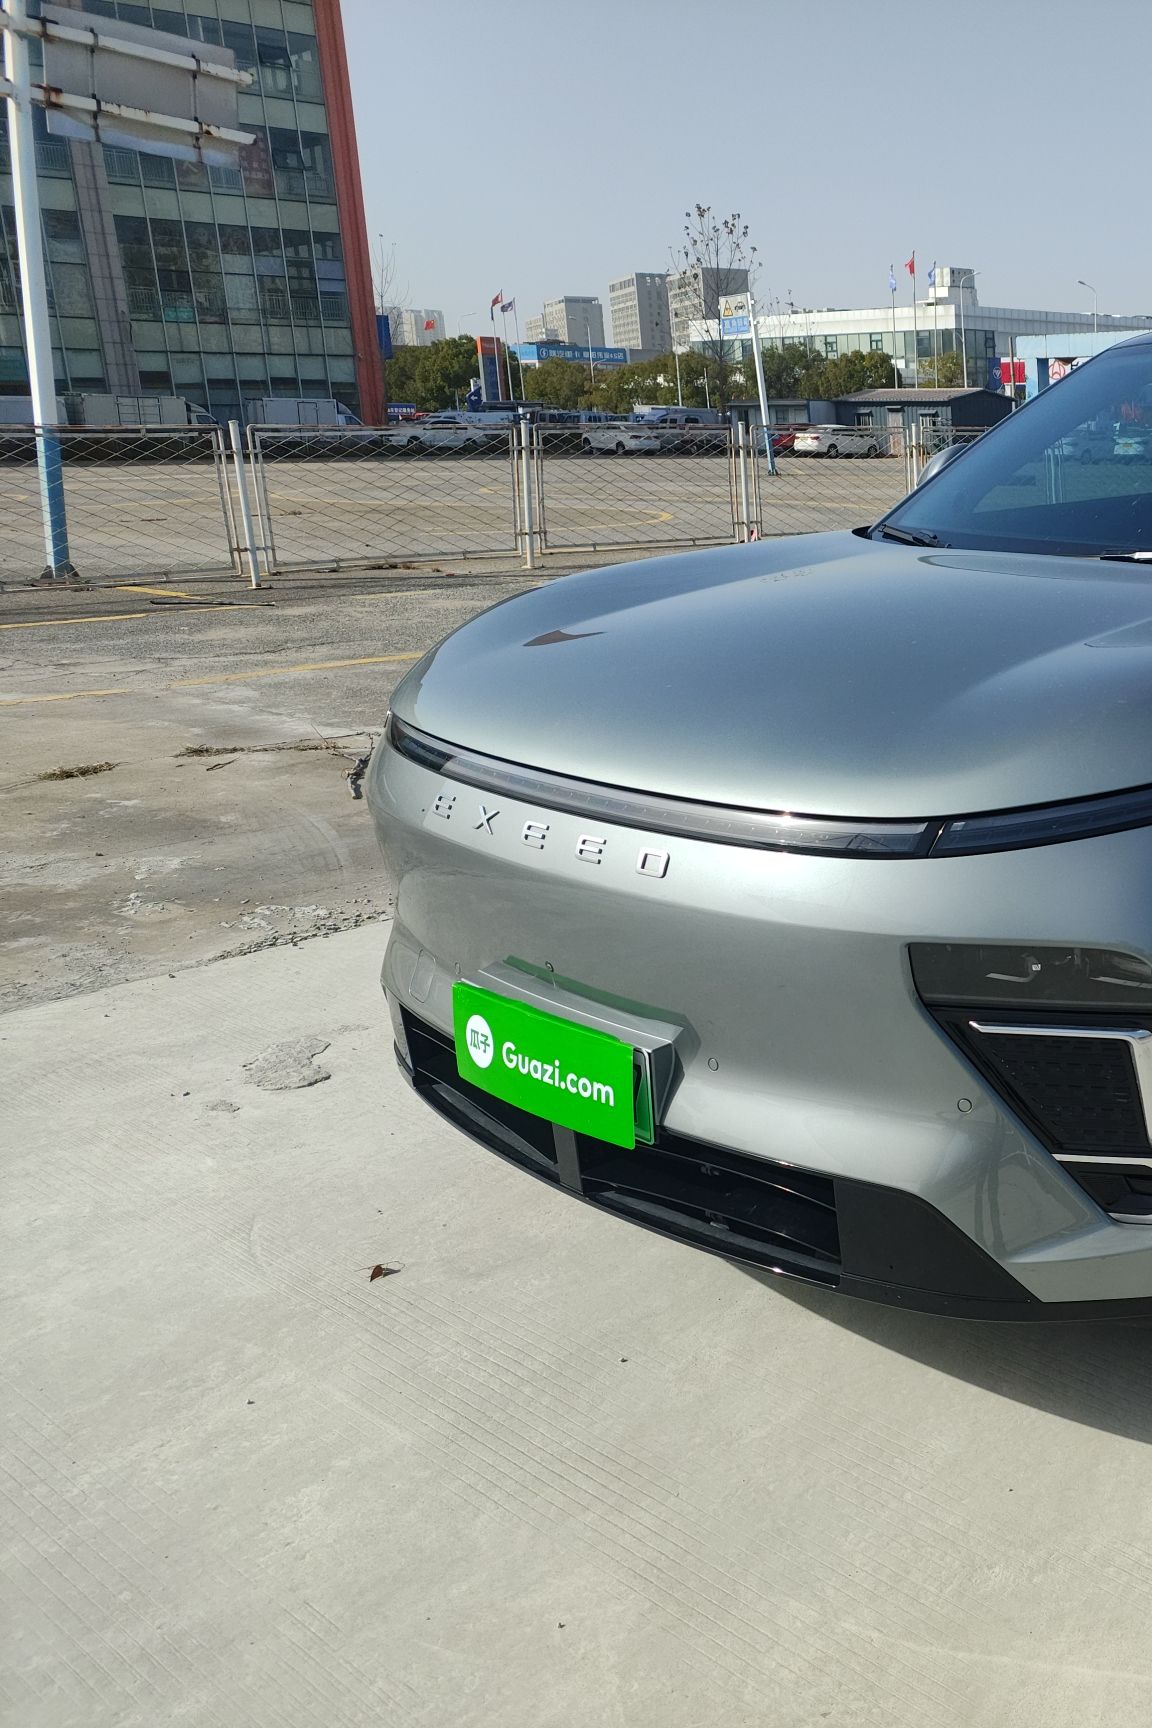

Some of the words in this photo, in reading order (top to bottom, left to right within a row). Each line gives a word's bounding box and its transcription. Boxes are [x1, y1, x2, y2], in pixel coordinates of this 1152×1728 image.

[432, 792, 671, 879] EXEED
[470, 1028, 491, 1054] 瓜子
[502, 1041, 615, 1107] Guazi.com
